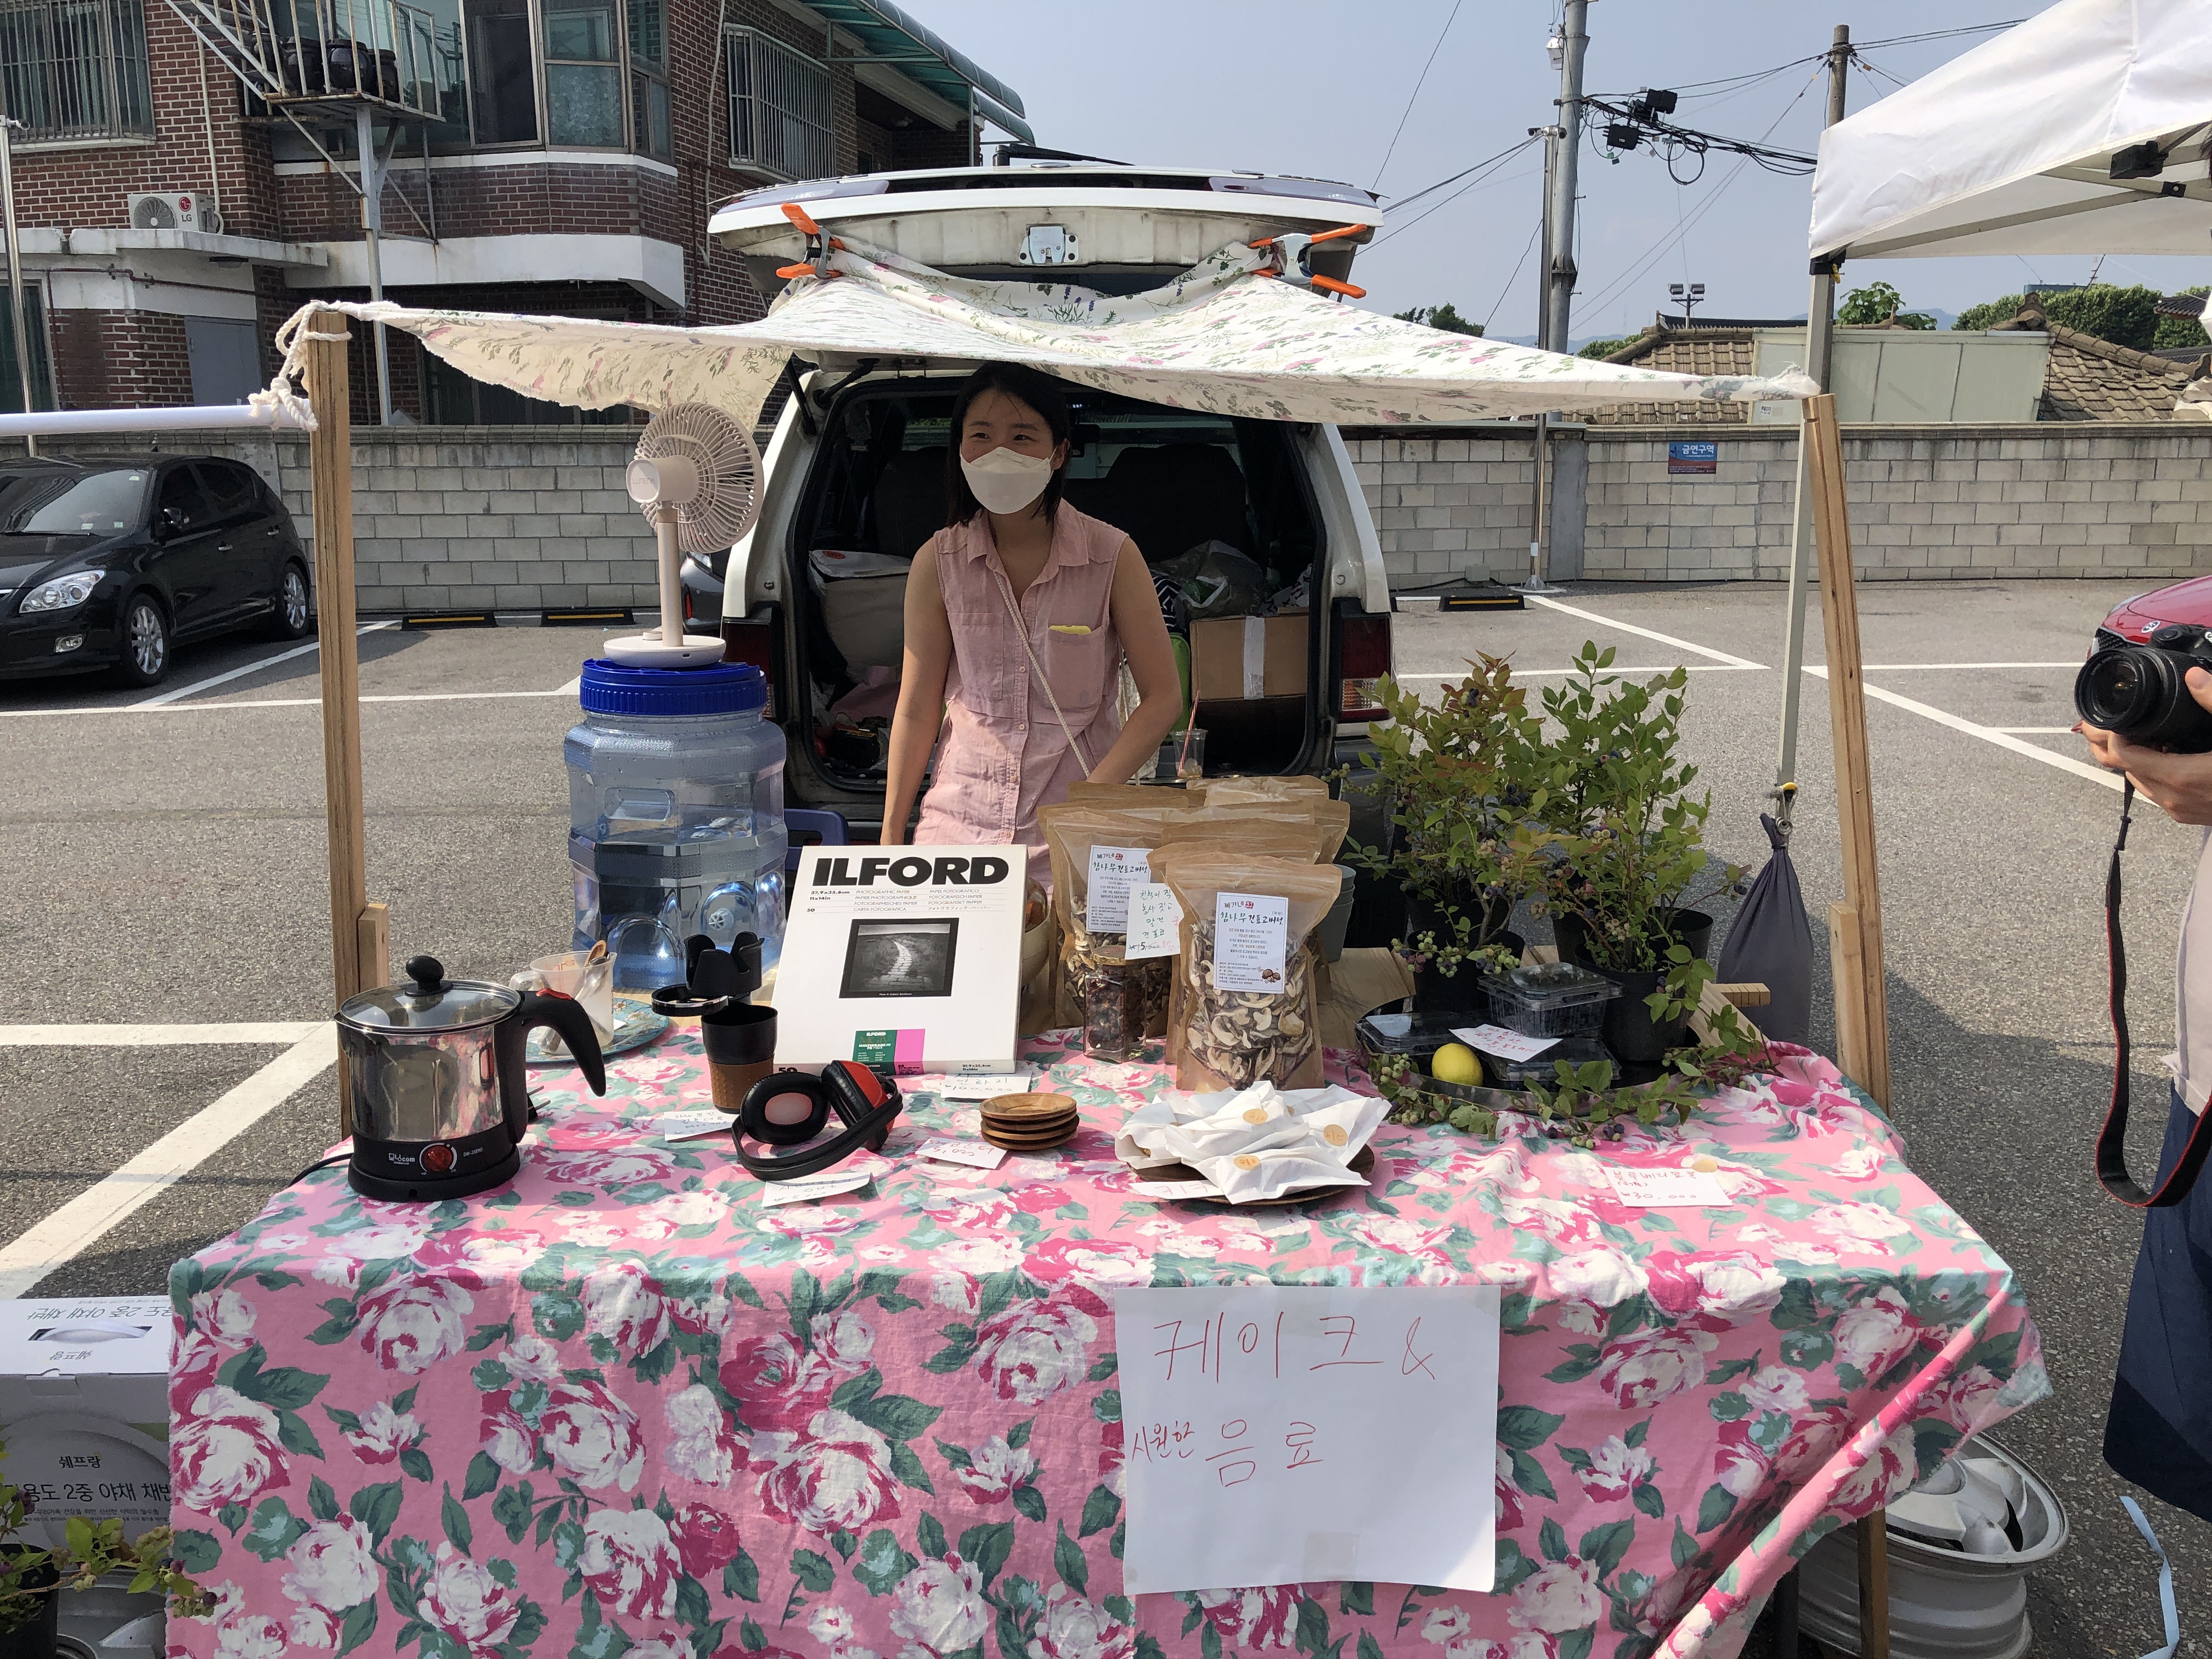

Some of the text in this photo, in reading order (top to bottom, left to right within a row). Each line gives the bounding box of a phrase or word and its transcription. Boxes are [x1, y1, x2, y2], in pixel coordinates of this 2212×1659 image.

[1681, 444, 1714, 454] 금연구역
[812, 856, 1009, 887] ILFORD
[1093, 861, 1116, 872] 참나무
[1140, 889, 1160, 900] 친척이
[1142, 903, 1156, 915] 농사
[1220, 911, 1247, 923] 참나무
[1613, 1170, 1668, 1181] 블루베리
[27, 1308, 66, 1320] 채반
[66, 1307, 105, 1319] 야채
[108, 1306, 142, 1318] 2중
[1153, 1311, 1435, 1384] 케이크 &
[49, 1350, 93, 1361] 쉐프랑
[1131, 1419, 1324, 1488] 시원한 음료
[59, 1456, 101, 1469] 쉐프랑
[4, 1483, 60, 1502] 용도
[63, 1483, 93, 1502] 2중
[99, 1482, 137, 1502] 야채
